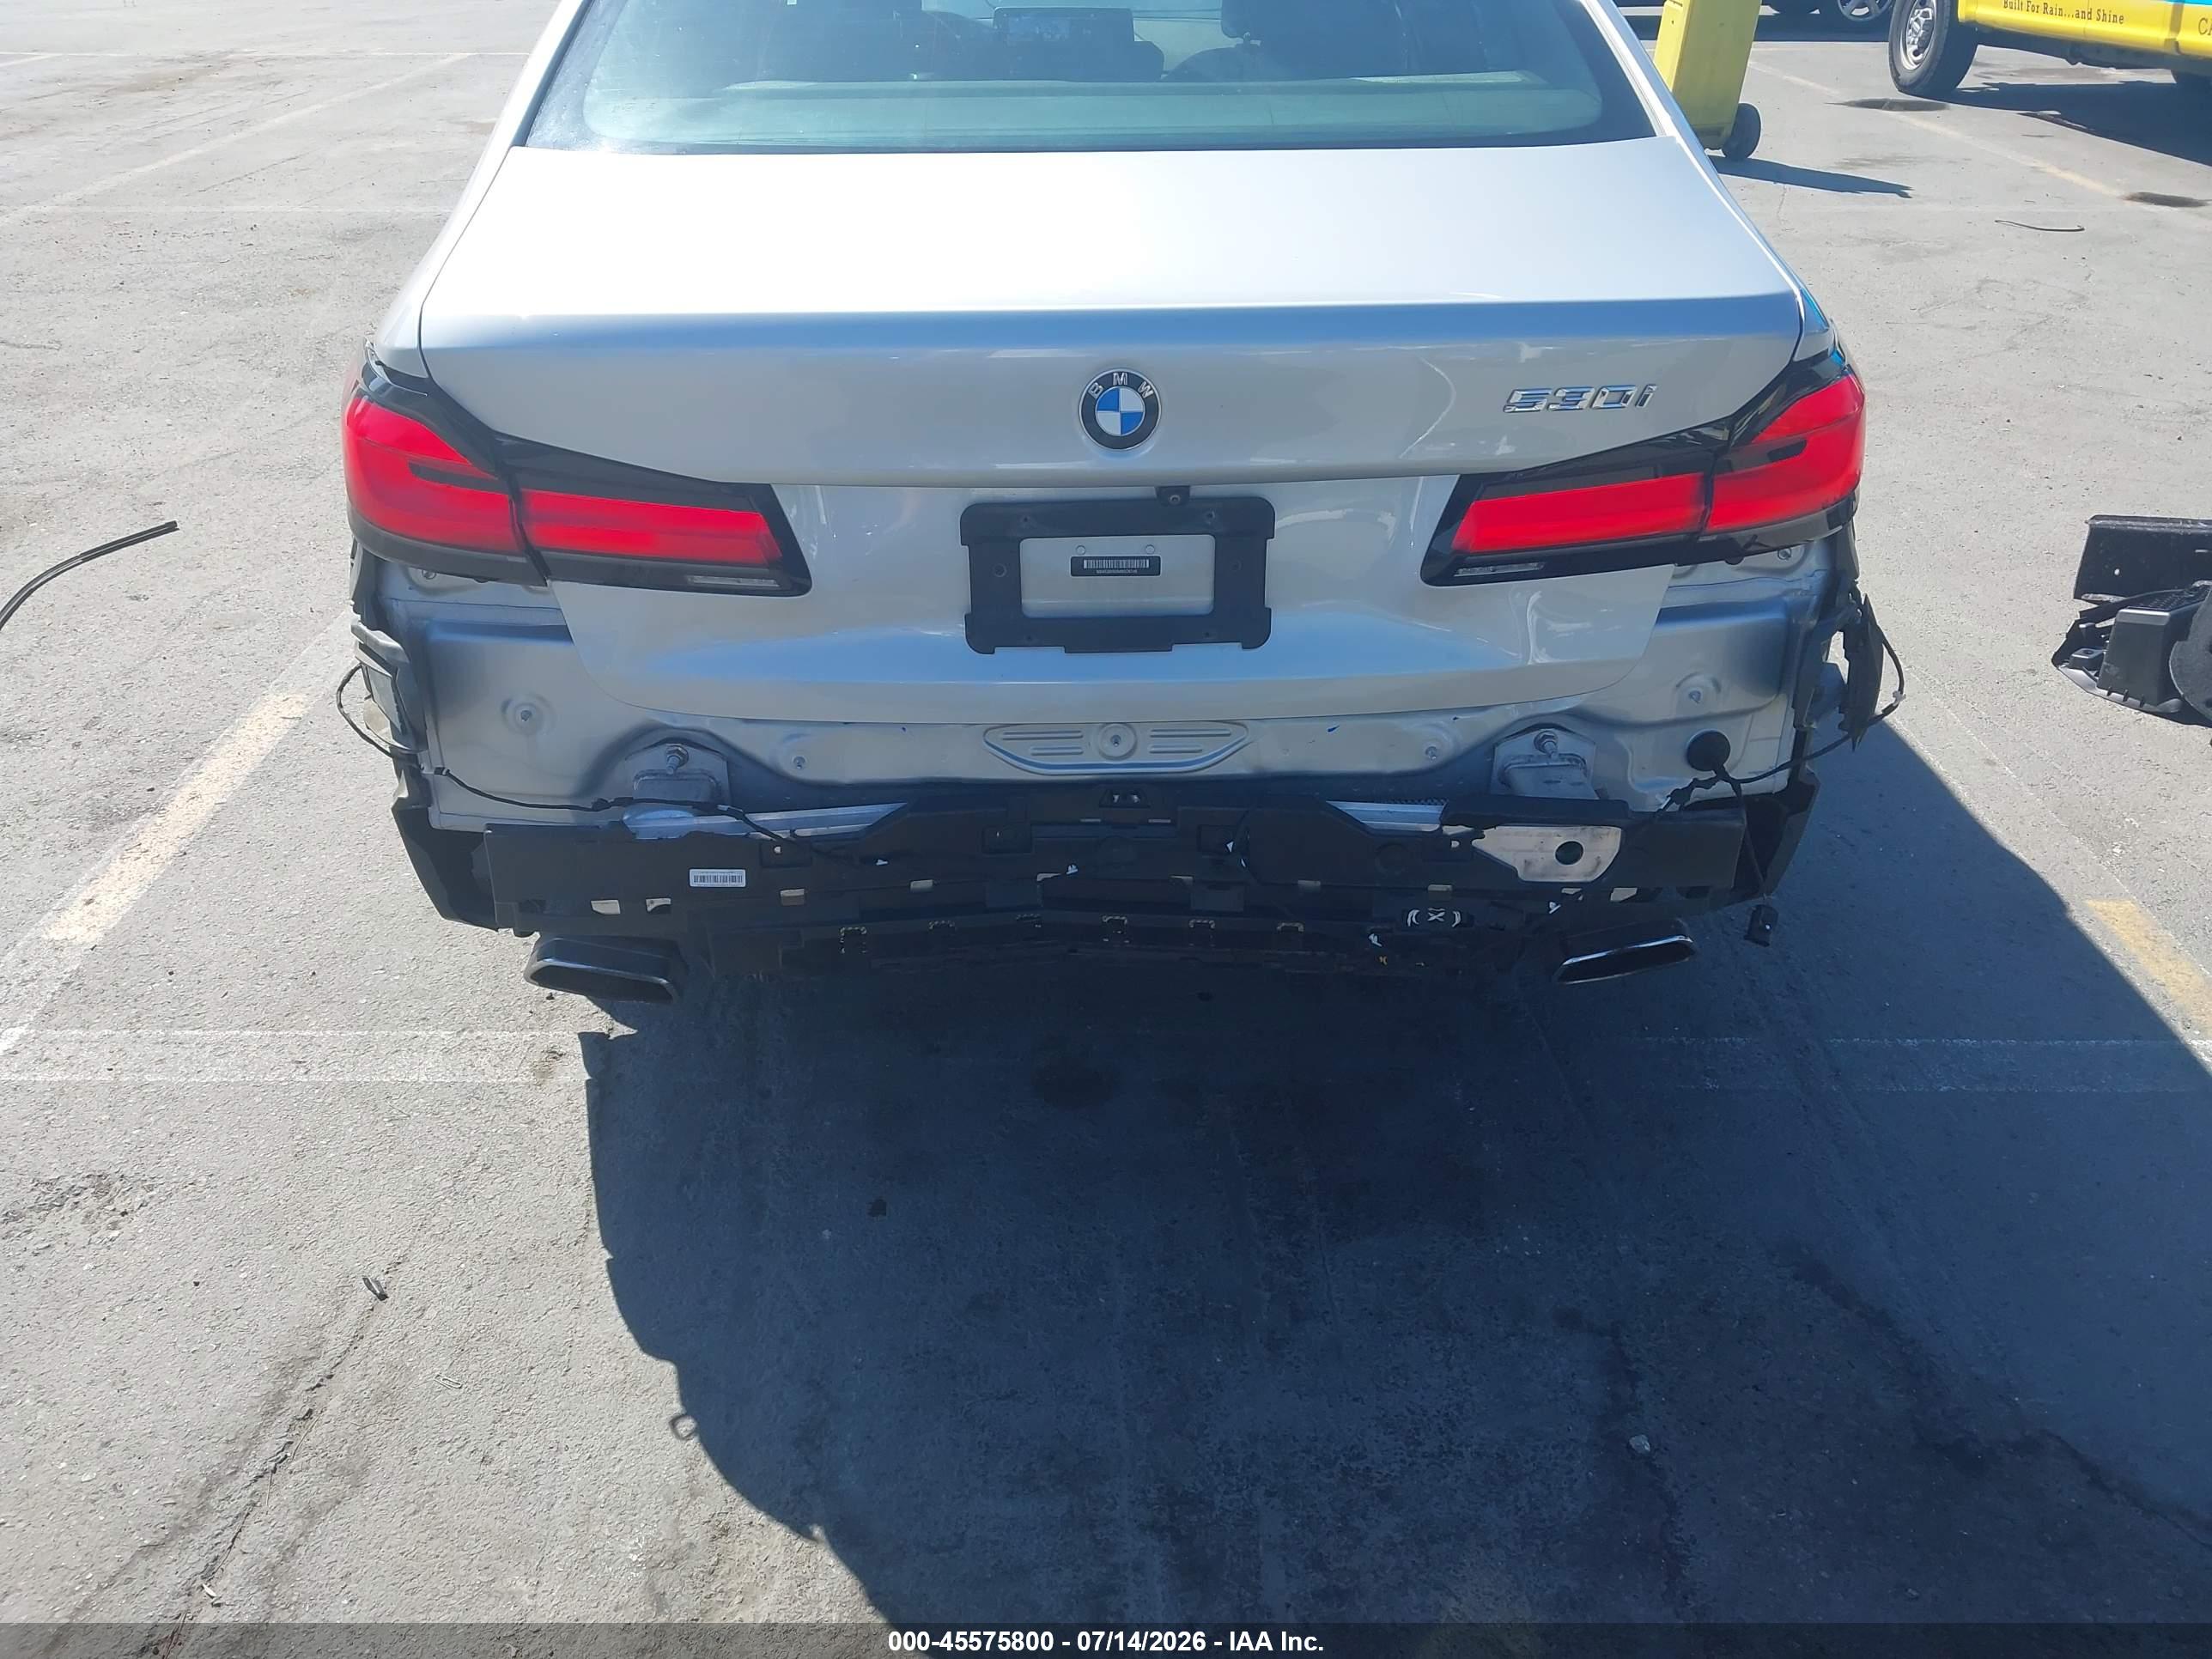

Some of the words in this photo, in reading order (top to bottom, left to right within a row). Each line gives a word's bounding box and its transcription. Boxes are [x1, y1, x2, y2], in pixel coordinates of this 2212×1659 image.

[2003, 0, 2023, 9] Built
[2027, 1, 2039, 13] For
[2096, 9, 2124, 24] Shine
[1088, 372, 1154, 399] BMW
[1503, 384, 1657, 413] 530i
